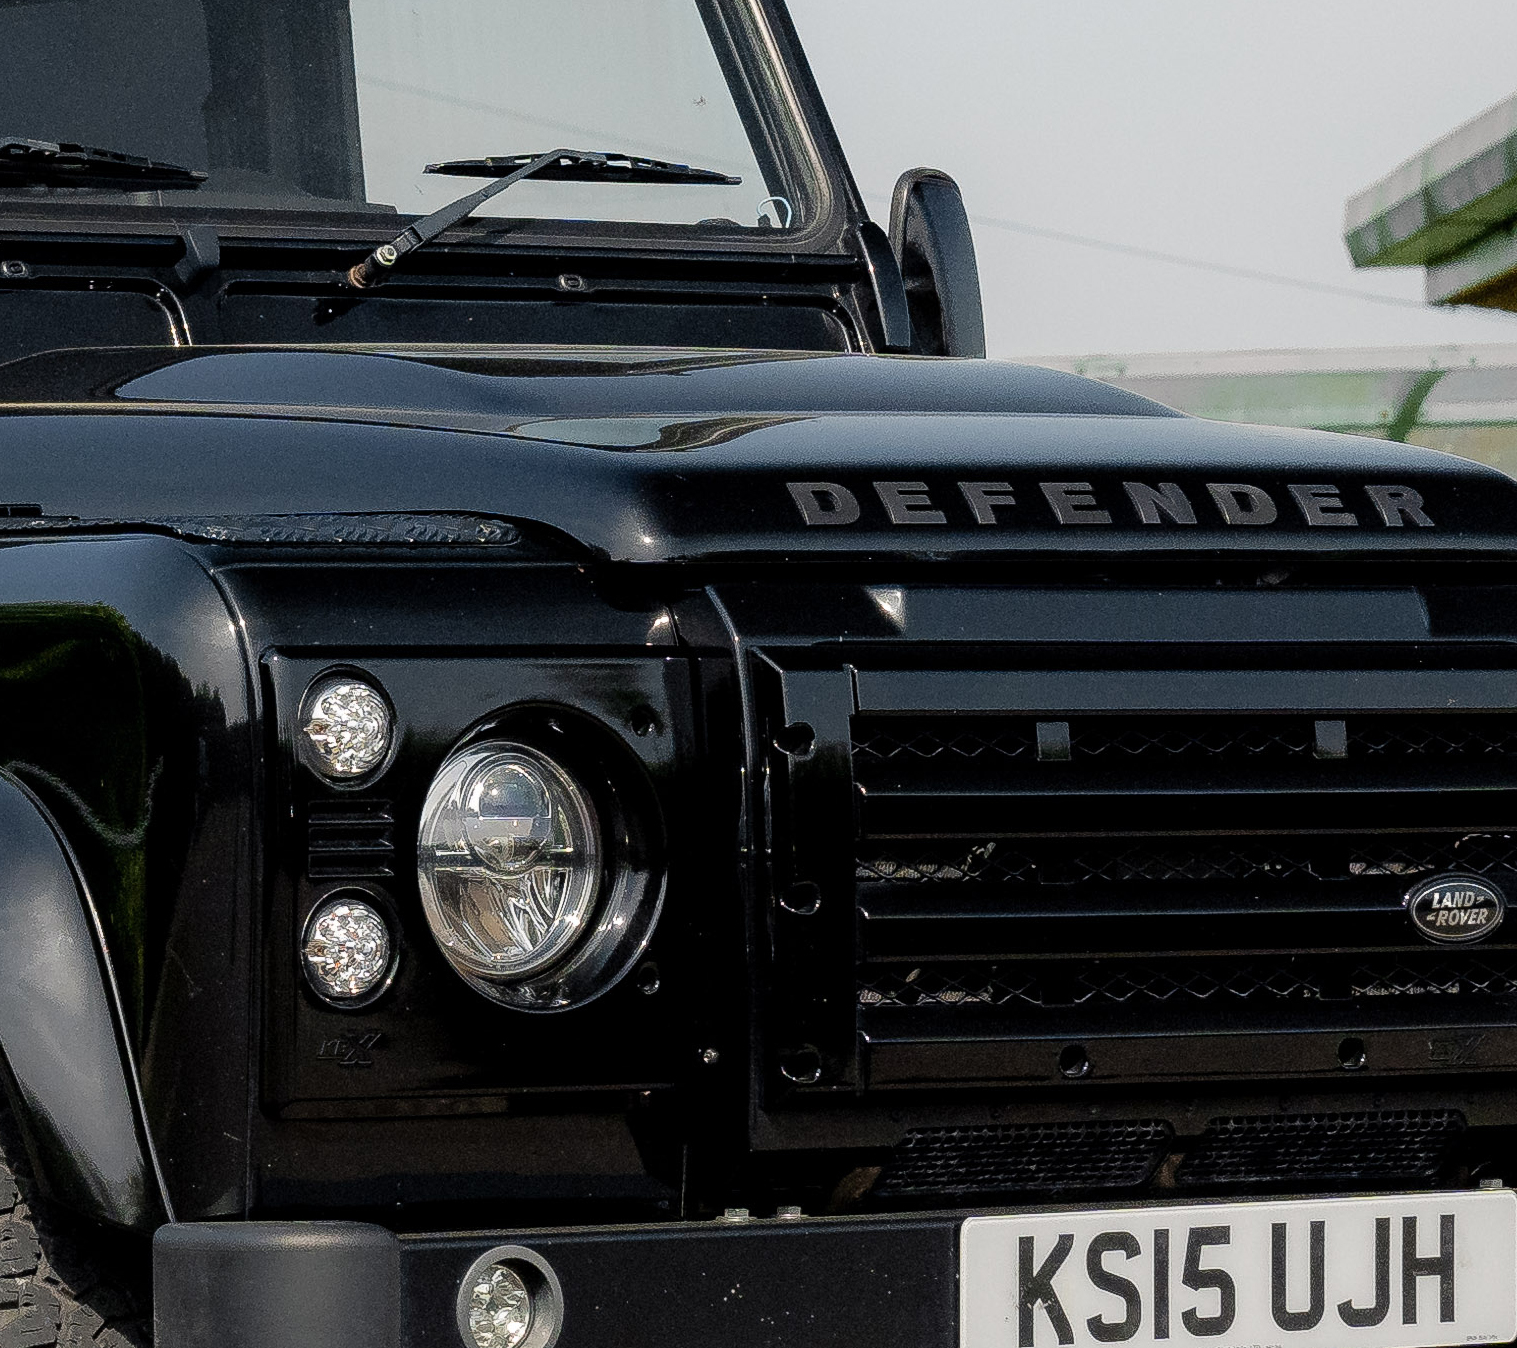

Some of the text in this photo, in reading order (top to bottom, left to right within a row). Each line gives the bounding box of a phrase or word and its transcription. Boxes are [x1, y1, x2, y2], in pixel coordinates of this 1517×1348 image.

[786, 481, 1435, 527] DEFENDER
[1431, 891, 1475, 909] LAND
[1435, 908, 1489, 926] ROVER
[1017, 1213, 1456, 1348] KS15 UJH
